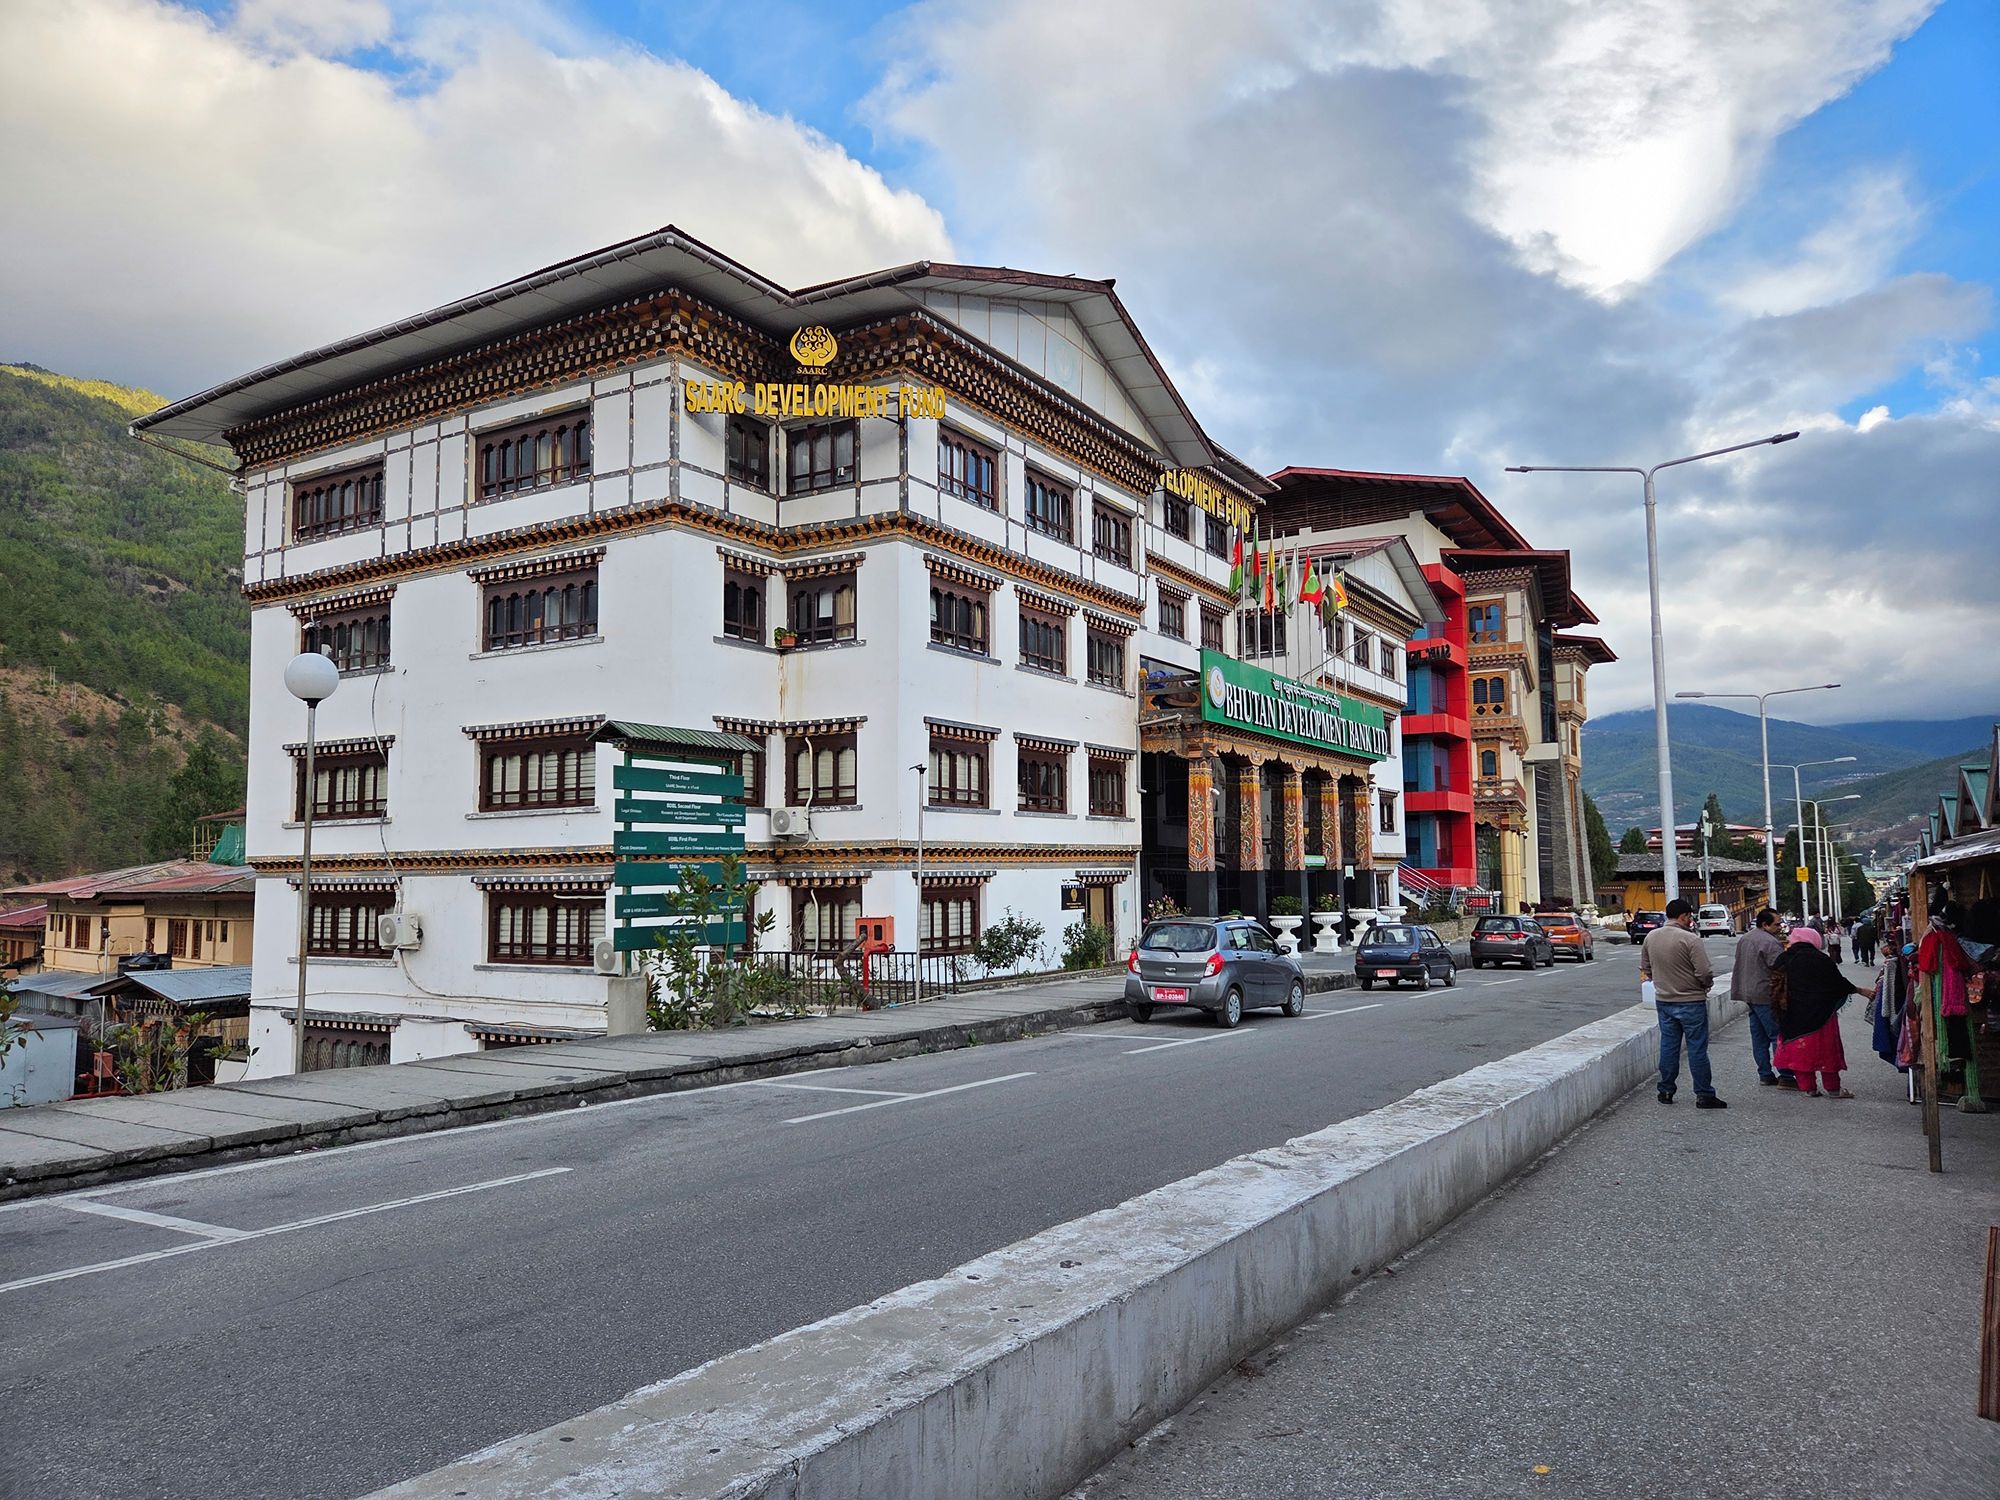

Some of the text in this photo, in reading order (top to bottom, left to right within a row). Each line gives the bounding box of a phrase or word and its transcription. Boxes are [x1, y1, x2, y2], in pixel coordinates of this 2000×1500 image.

[796, 366, 828, 375] SAARC
[685, 379, 947, 419] SAARC DEVELOPMENT FUND
[1225, 682, 1388, 755] BHUTAN DEVELOPMENT BANK LTD
